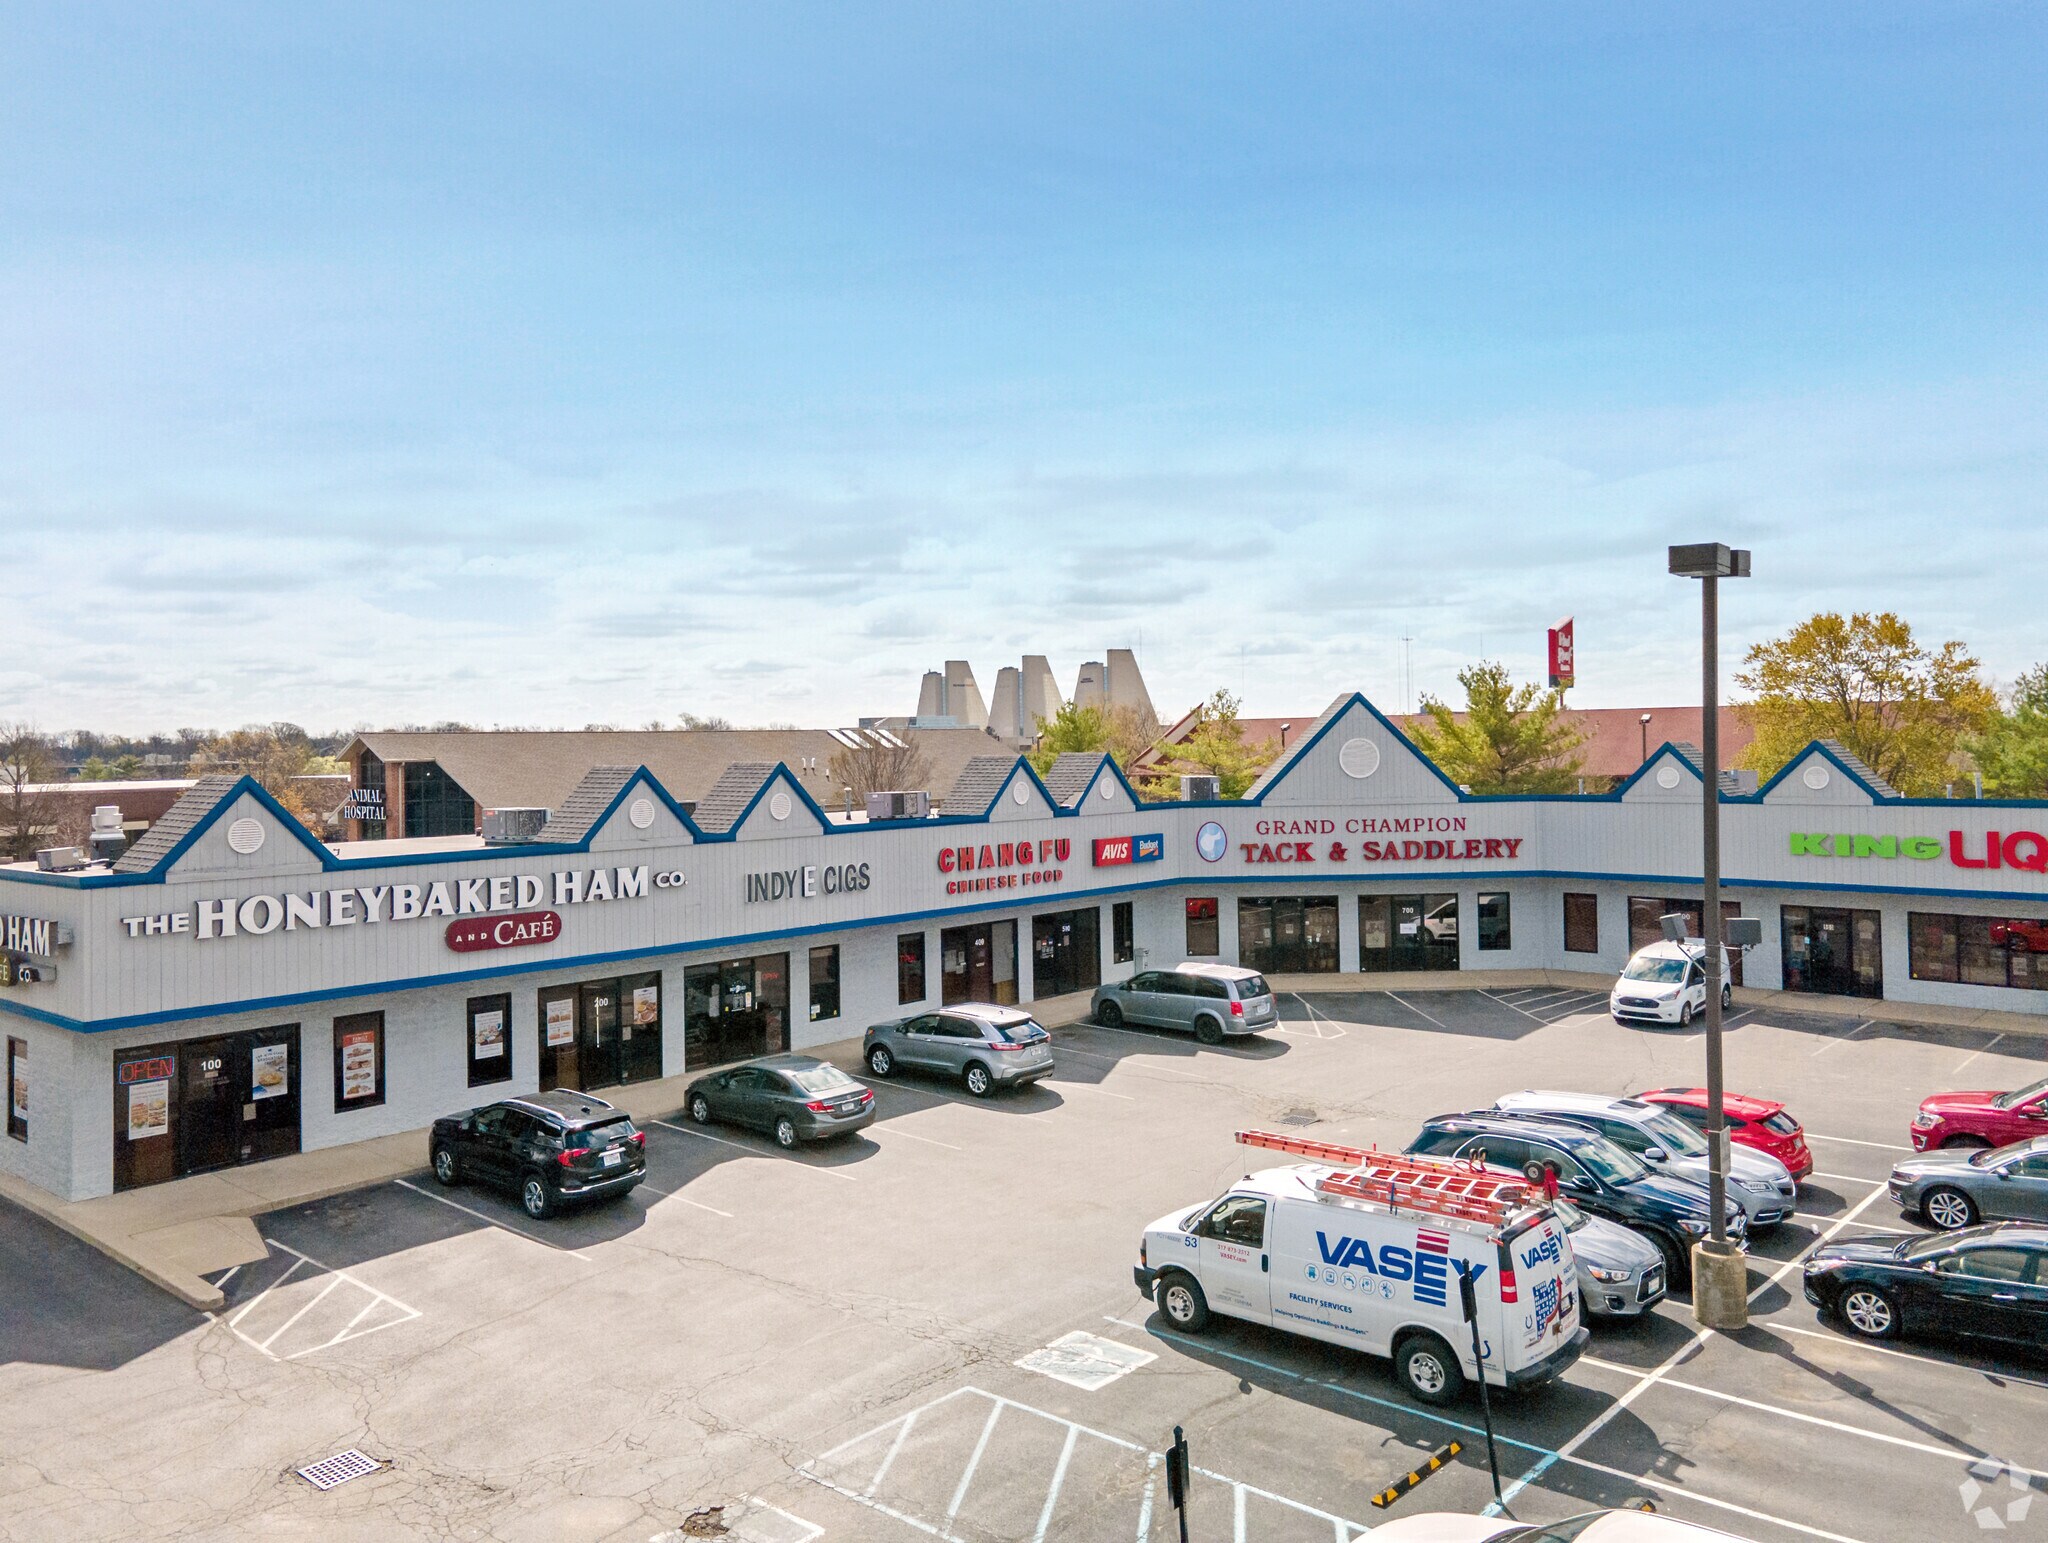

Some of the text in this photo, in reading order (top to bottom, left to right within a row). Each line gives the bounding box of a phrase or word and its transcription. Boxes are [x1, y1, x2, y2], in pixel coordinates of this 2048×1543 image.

[349, 789, 382, 803] ANIMAL
[344, 805, 387, 820] HOSPITAL
[1256, 817, 1467, 835] GRAND CHAMPION
[938, 838, 1071, 873] CHANG FU
[1102, 843, 1128, 860] AVIS
[1139, 839, 1159, 851] Budget
[1240, 838, 1523, 863] TACK & SADDLERY
[1789, 830, 2048, 874] KING LIQ
[746, 862, 870, 903] INDY E CIGS
[947, 870, 1063, 895] CHINESE FOOD
[121, 912, 190, 938] THE
[195, 875, 544, 940] HONEYBAKED
[552, 865, 649, 905] HAM
[8, 915, 51, 957] HAM
[455, 932, 487, 943] AND
[121, 1057, 173, 1082] OPEN
[201, 1058, 222, 1071] 100
[1184, 1236, 1198, 1248] 53
[1520, 1232, 1564, 1269] VASEY
[1316, 1231, 1488, 1291] VASEY
[1289, 1292, 1353, 1314] FACILITY SERVICES
[1274, 1308, 1294, 1318] Helping
[1294, 1313, 1316, 1323] Optimize
